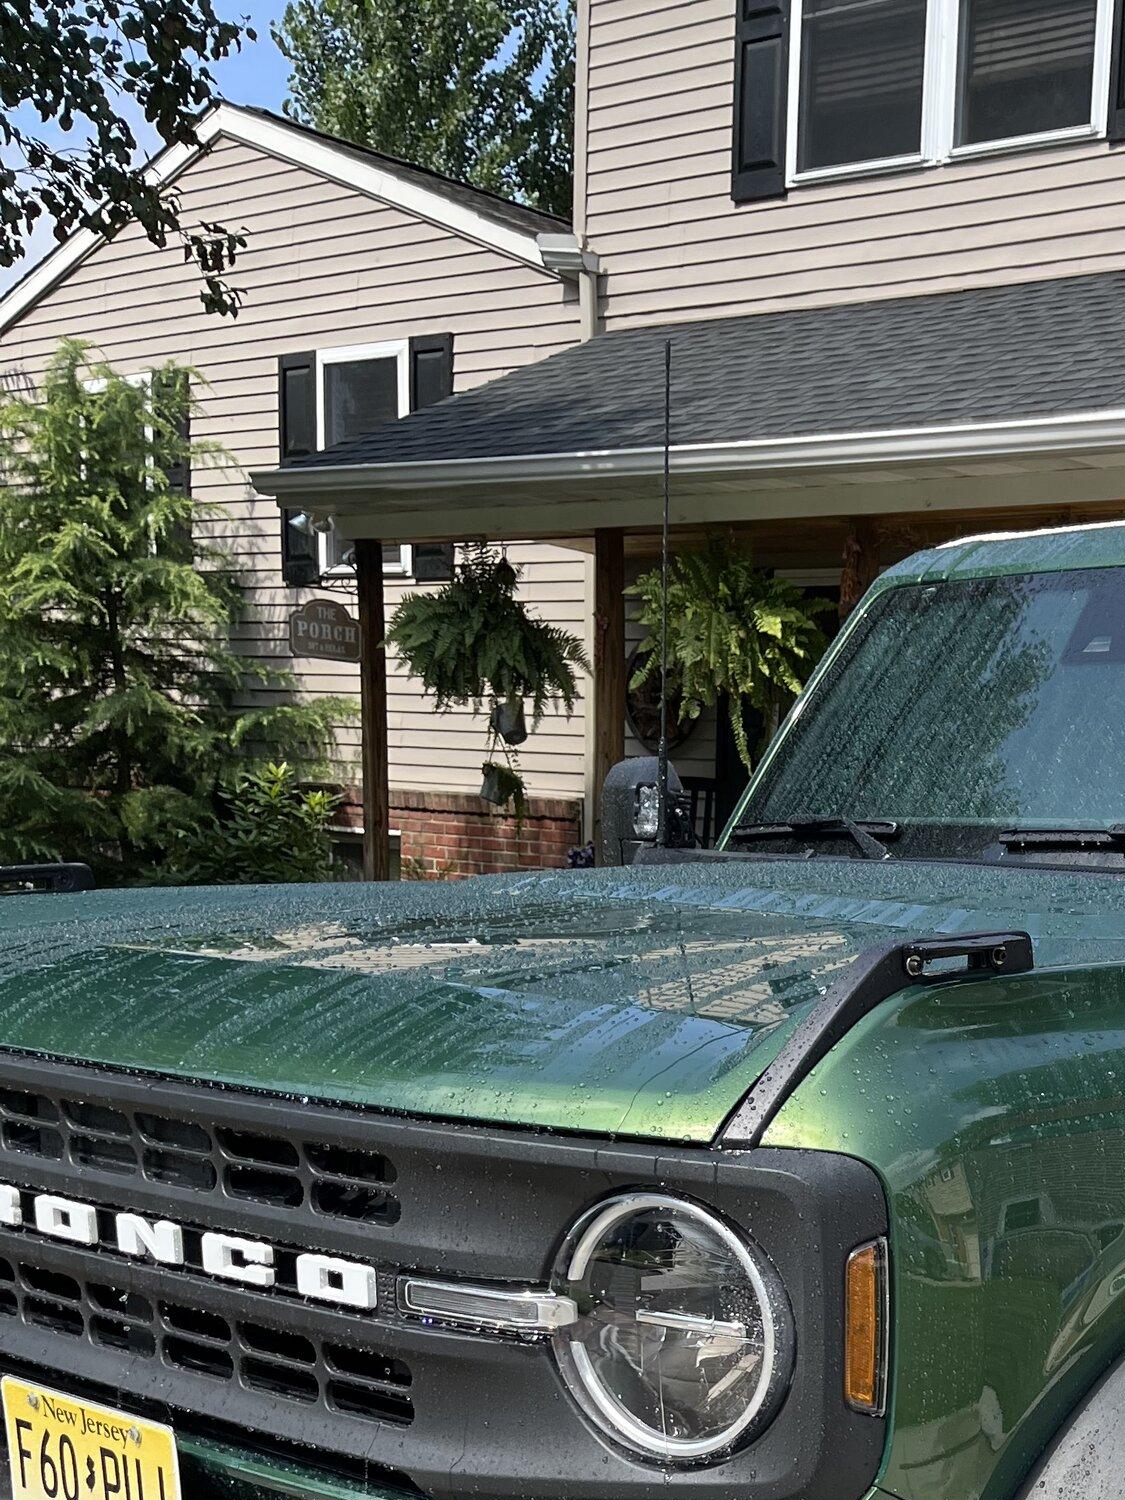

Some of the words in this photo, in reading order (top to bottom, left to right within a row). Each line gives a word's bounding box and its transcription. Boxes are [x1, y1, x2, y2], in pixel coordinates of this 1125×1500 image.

[316, 606, 337, 621] THE
[296, 620, 357, 643] PORCH
[42, 1394, 78, 1427] New
[79, 1408, 131, 1449] Jersey
